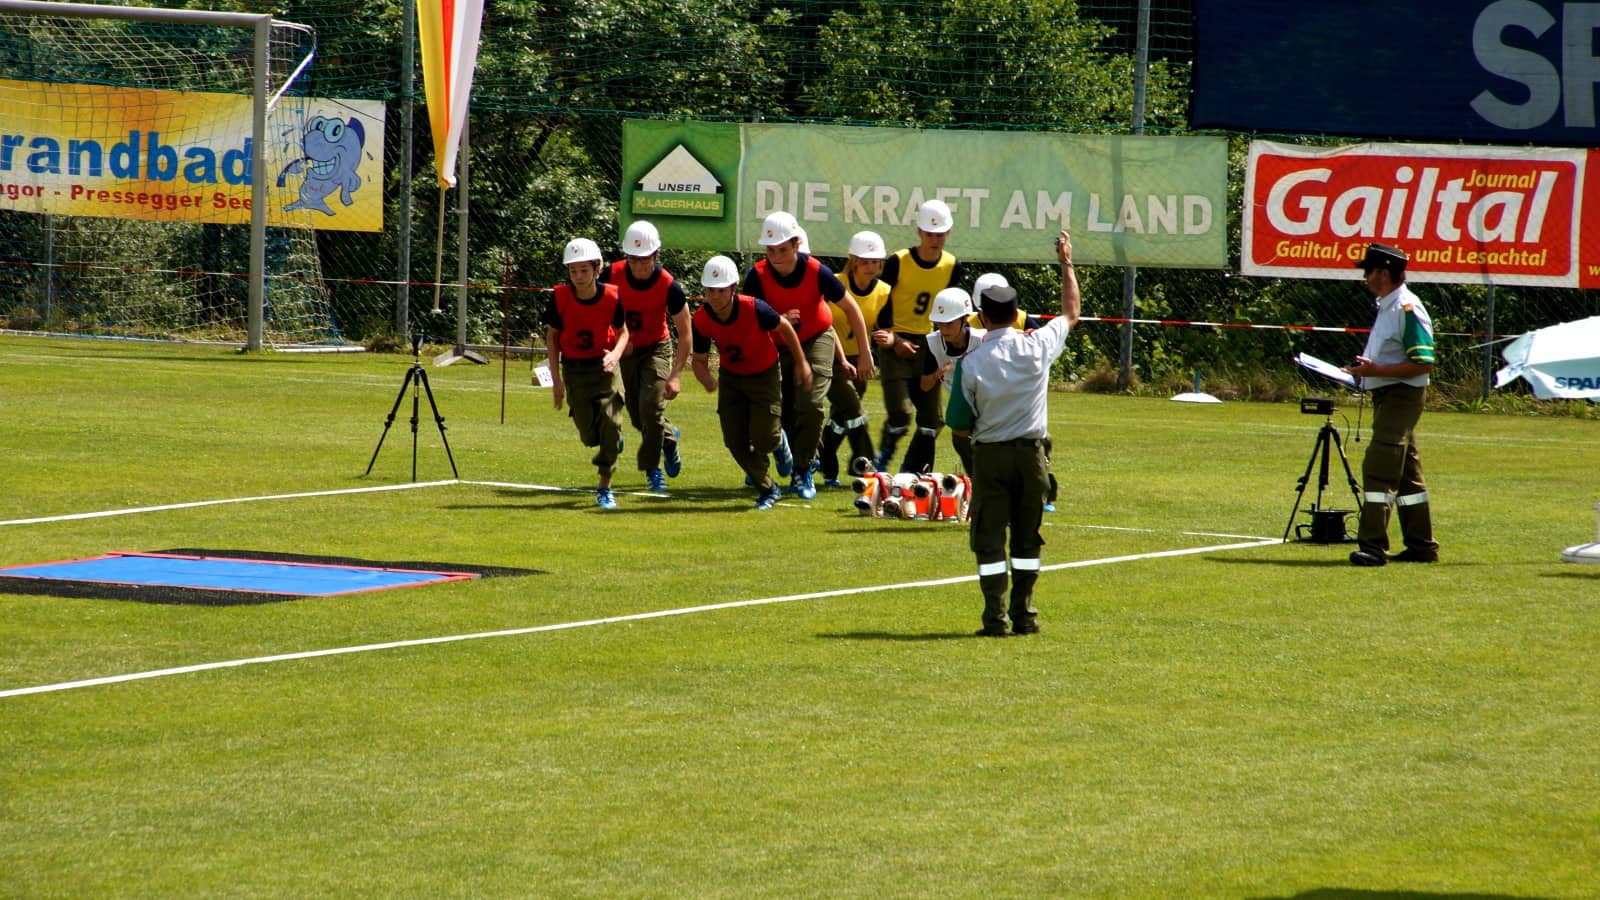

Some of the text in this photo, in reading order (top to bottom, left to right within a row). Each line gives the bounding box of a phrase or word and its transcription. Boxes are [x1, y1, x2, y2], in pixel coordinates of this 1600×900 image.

[658, 183, 701, 192] UNSER
[1466, 169, 1537, 188] Journal
[70, 184, 203, 210] Pressegger
[213, 192, 252, 210] See
[647, 199, 720, 211] LAGERHAUS
[1265, 165, 1559, 244] Gailtal
[755, 180, 1213, 235] DIE KRAFT AM LAND
[1276, 240, 1342, 262] Gailtal,
[1415, 246, 1452, 264] und
[1456, 247, 1547, 266] Lesachtal
[914, 292, 931, 315] 9
[625, 311, 642, 331] 5
[576, 331, 594, 349] 3
[725, 345, 744, 363] 2
[1554, 376, 1600, 391] SPA
